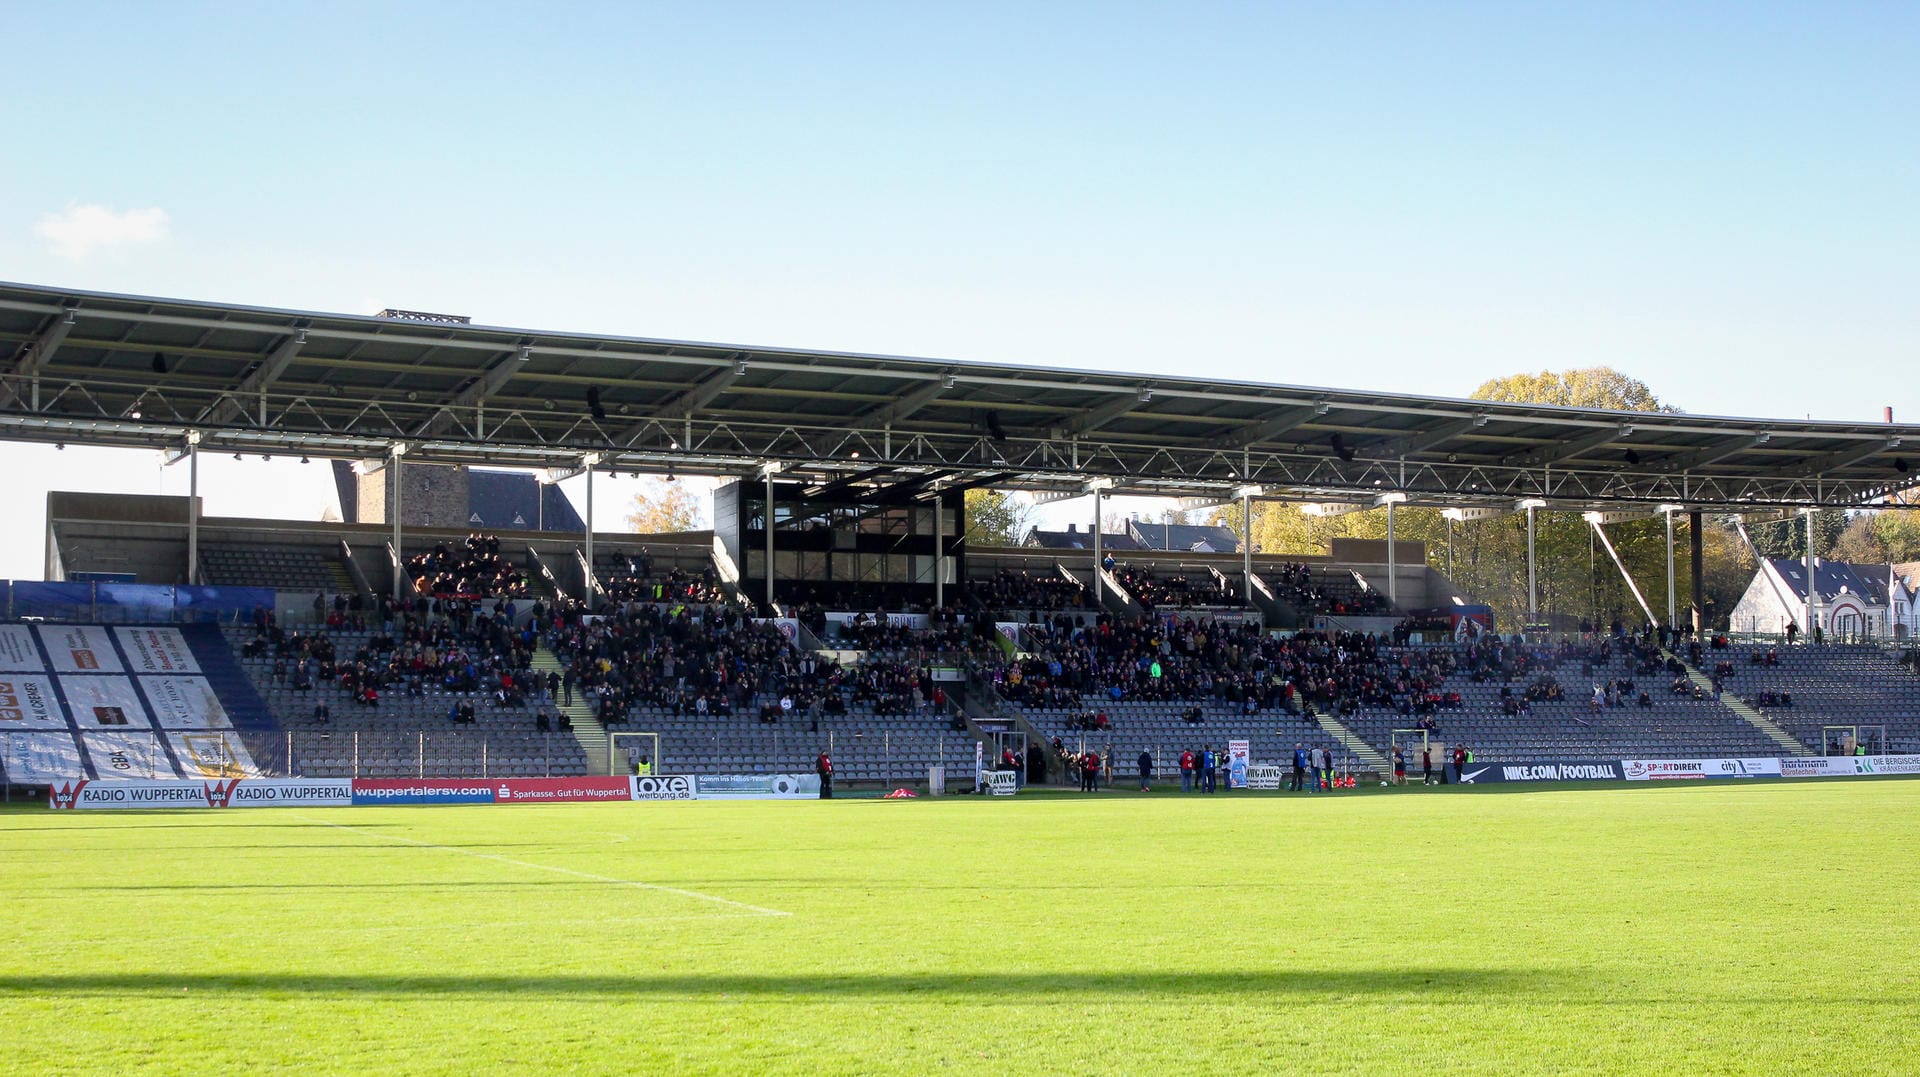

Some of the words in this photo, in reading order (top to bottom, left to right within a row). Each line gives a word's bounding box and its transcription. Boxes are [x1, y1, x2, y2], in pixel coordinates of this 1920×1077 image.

[160, 679, 181, 701] HORN
[174, 703, 193, 724] PAUL
[106, 750, 131, 770] GBA
[1721, 760, 1736, 773] city
[1502, 763, 1617, 780] NIKE.COM/FOOTBALL
[993, 773, 1015, 784] AWG
[84, 789, 125, 801] RADIO
[130, 788, 204, 800] WUPPERTAL
[236, 788, 277, 800] RADIO
[280, 787, 351, 799] WUPPERTAL
[355, 786, 491, 798] wuppertalersv.com
[513, 789, 556, 799] Sparkasse.
[557, 789, 571, 798] Gut
[573, 788, 585, 797] für
[585, 787, 629, 798] Wuppertal.
[638, 792, 690, 800] werbung.de
